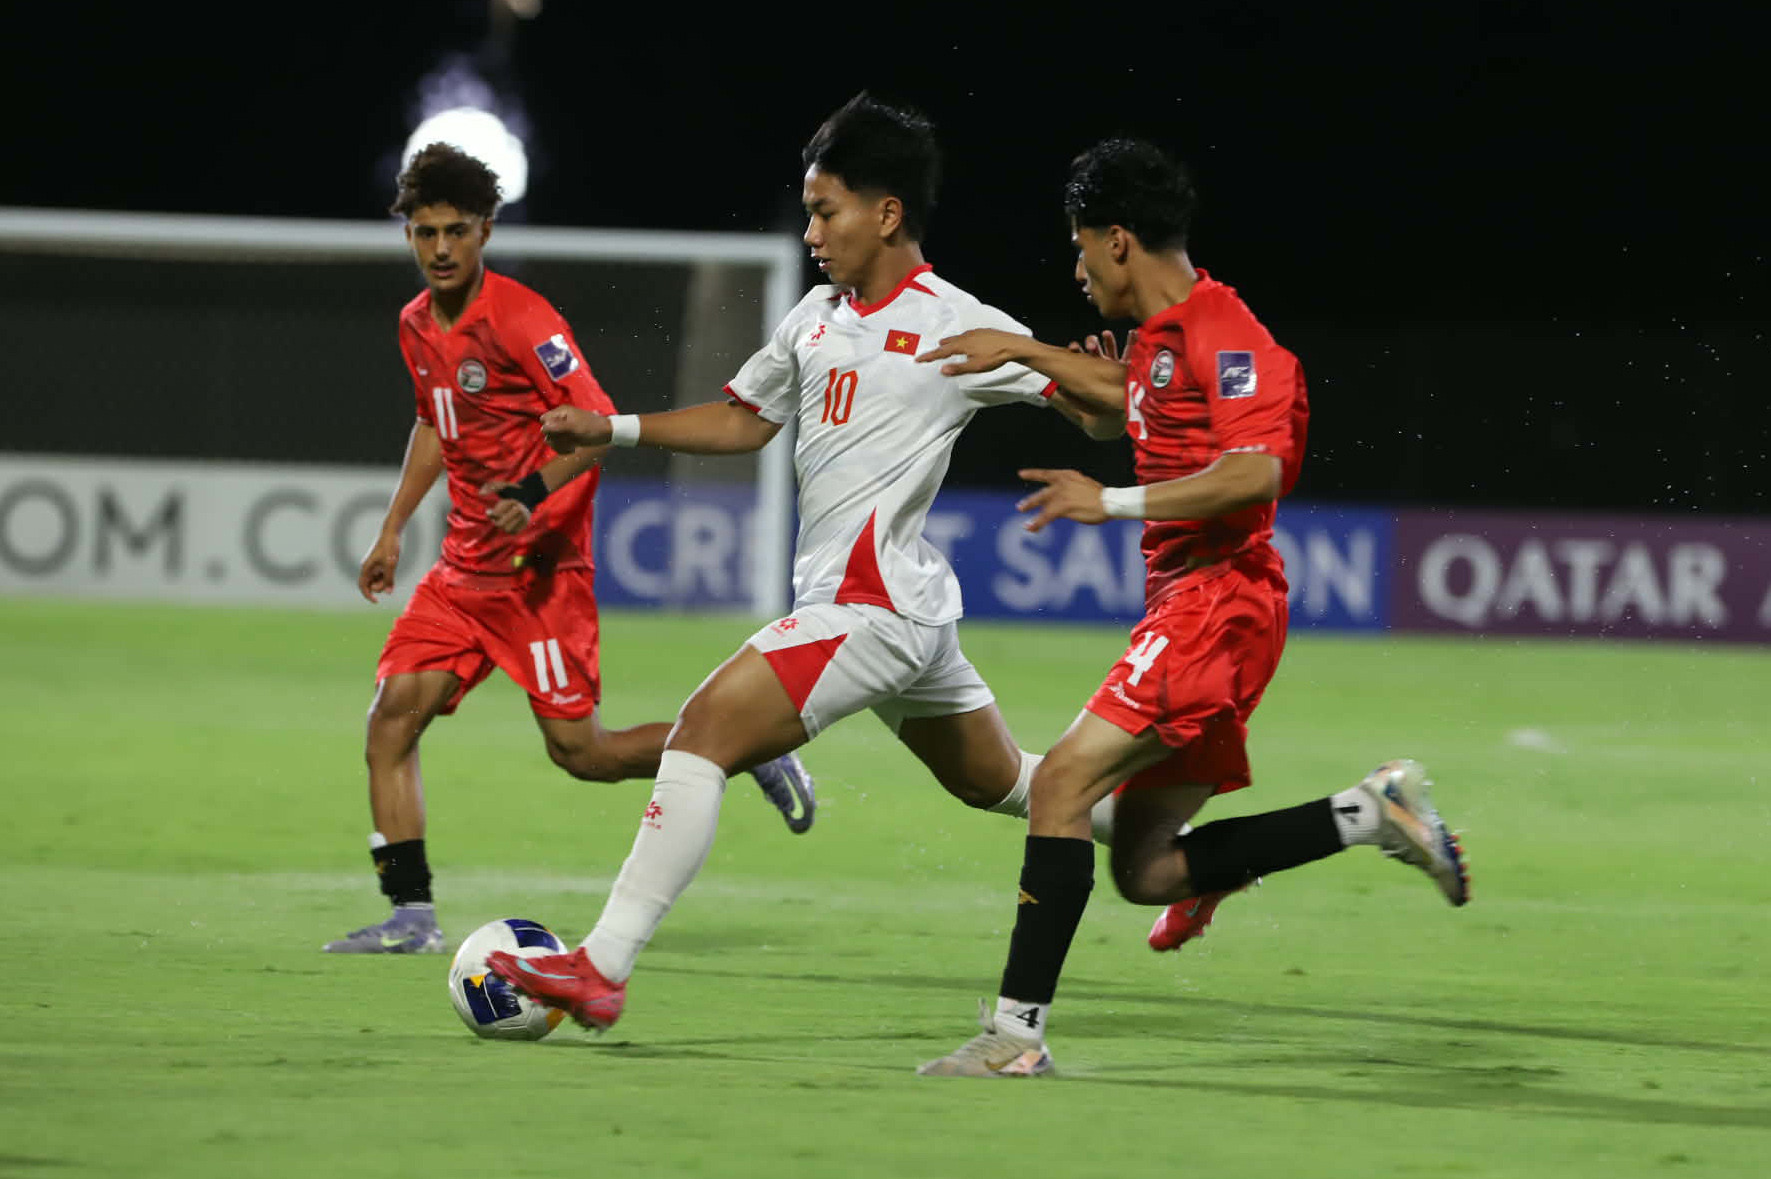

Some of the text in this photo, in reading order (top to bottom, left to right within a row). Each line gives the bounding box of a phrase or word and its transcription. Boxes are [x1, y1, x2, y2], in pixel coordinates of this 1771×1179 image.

[432, 387, 459, 440] 11
[821, 367, 859, 426] 10
[1416, 533, 1728, 627] QATAR
[529, 638, 569, 693] 11
[1125, 631, 1170, 687] 4
[1016, 1006, 1040, 1029] 4
